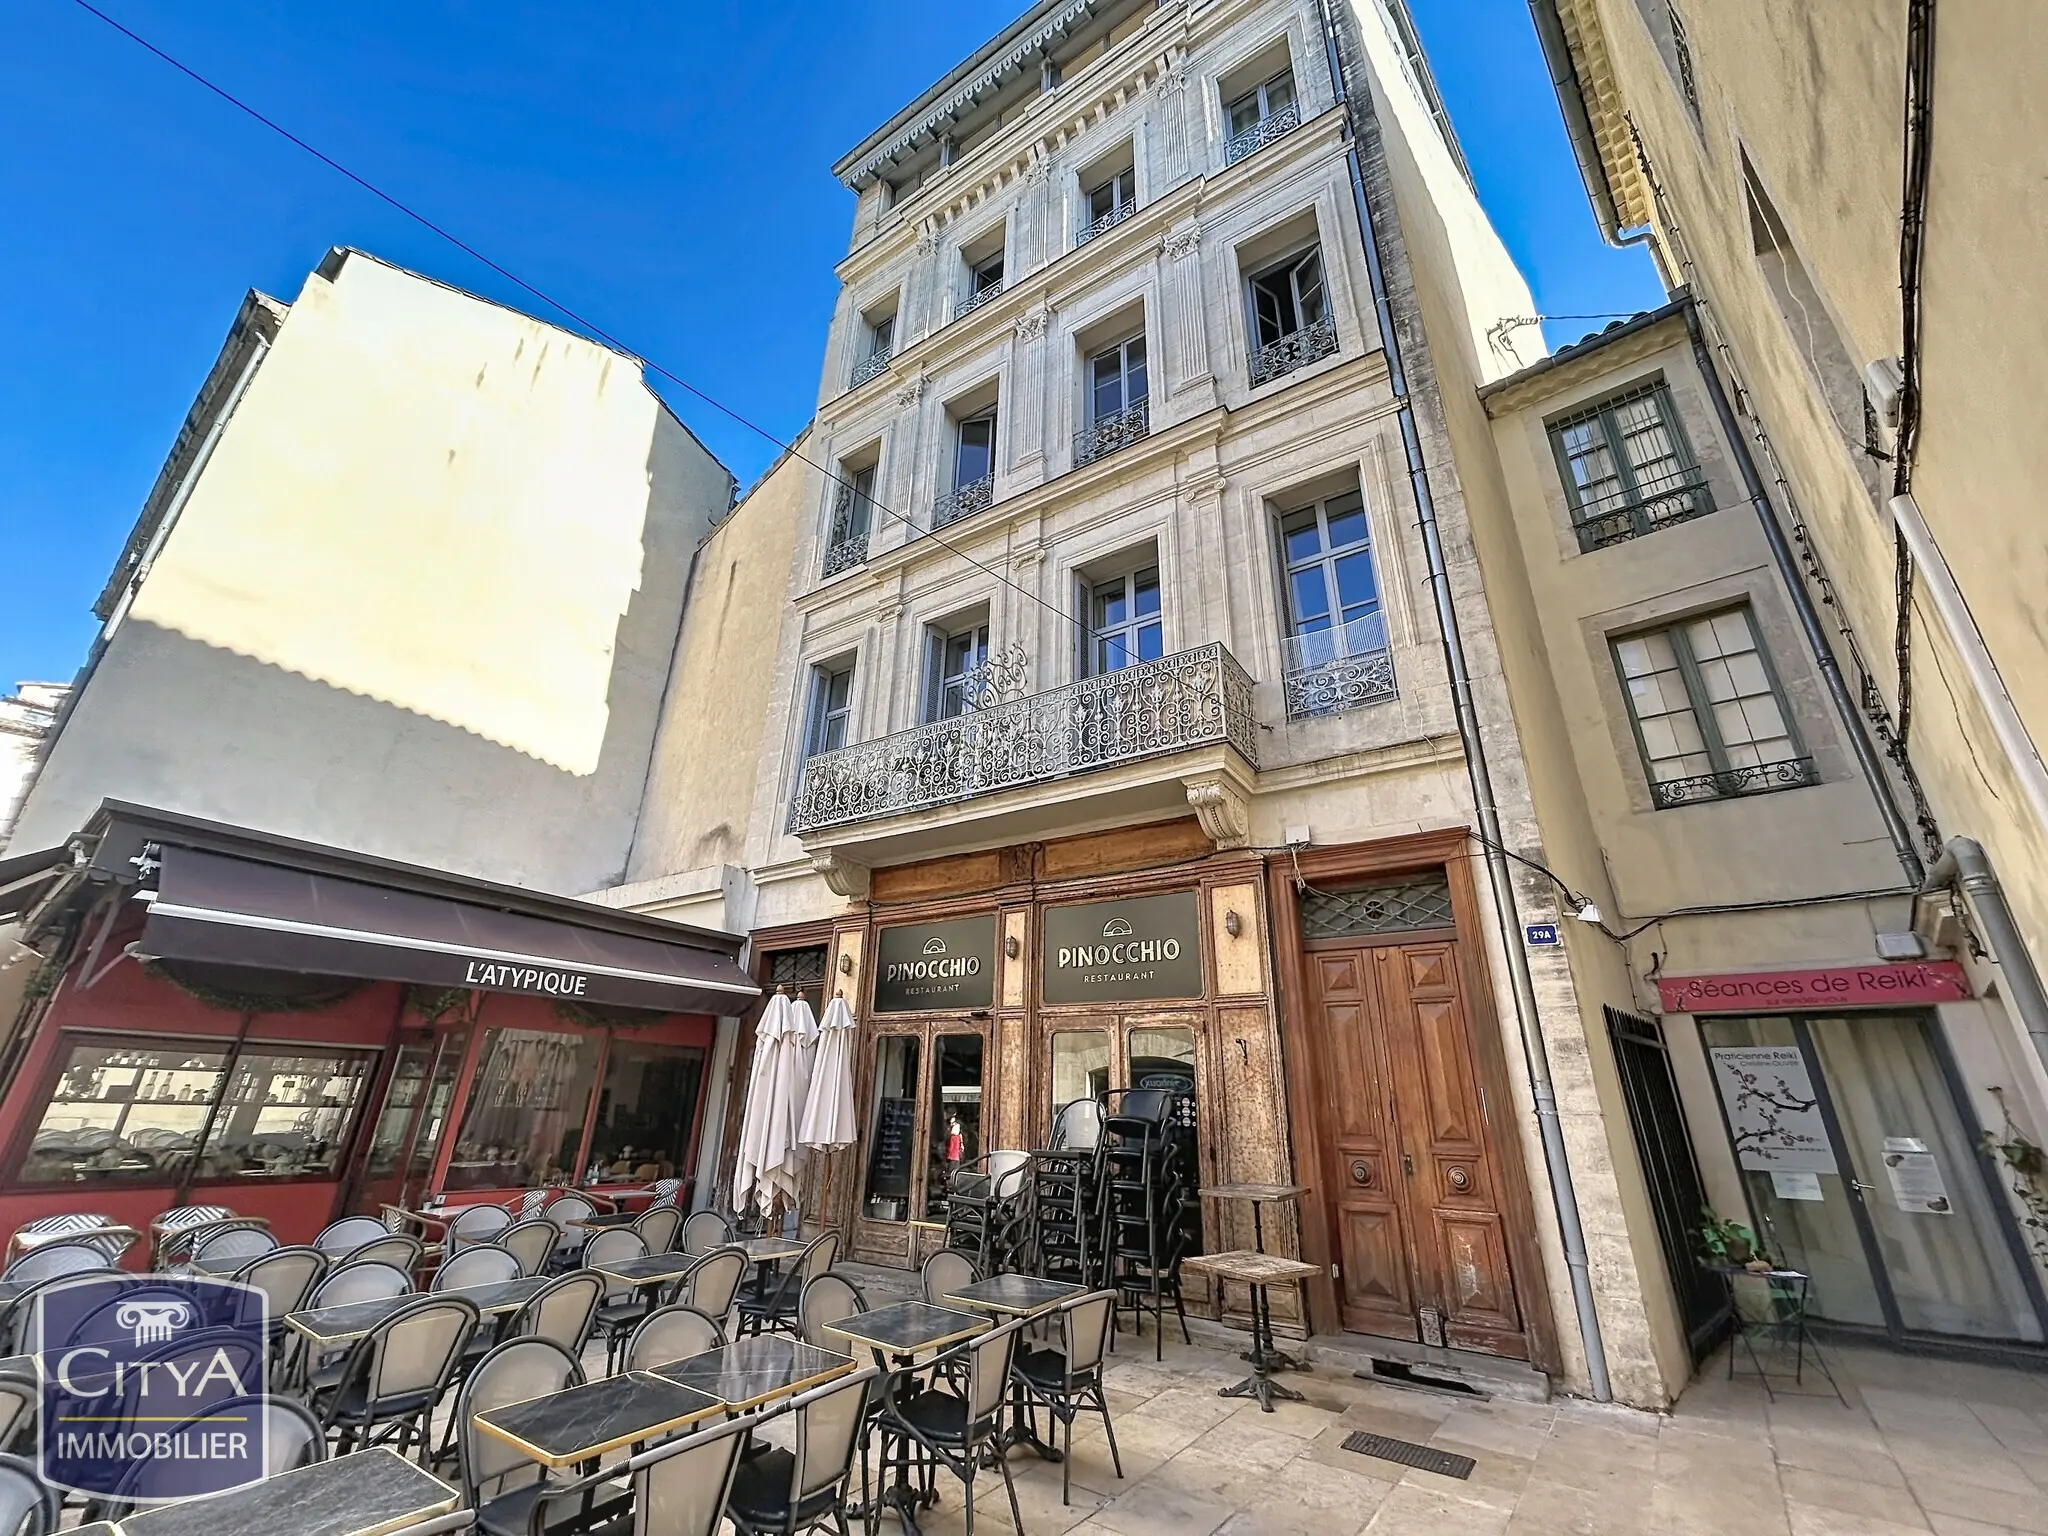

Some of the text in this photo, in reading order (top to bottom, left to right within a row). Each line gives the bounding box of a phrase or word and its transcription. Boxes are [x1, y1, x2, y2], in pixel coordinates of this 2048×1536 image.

[1532, 930, 1552, 940] 29A
[1058, 938, 1181, 968] PINOCCHIO
[465, 961, 587, 995] L'ATYPIQUE
[887, 956, 980, 982] PINOCCHIO
[1084, 970, 1155, 983] RESTAURANT
[905, 983, 960, 995] RESTAURANT
[1688, 967, 1928, 998] Séances de Reiki
[1714, 1051, 1798, 1060] Praticienne Reiki
